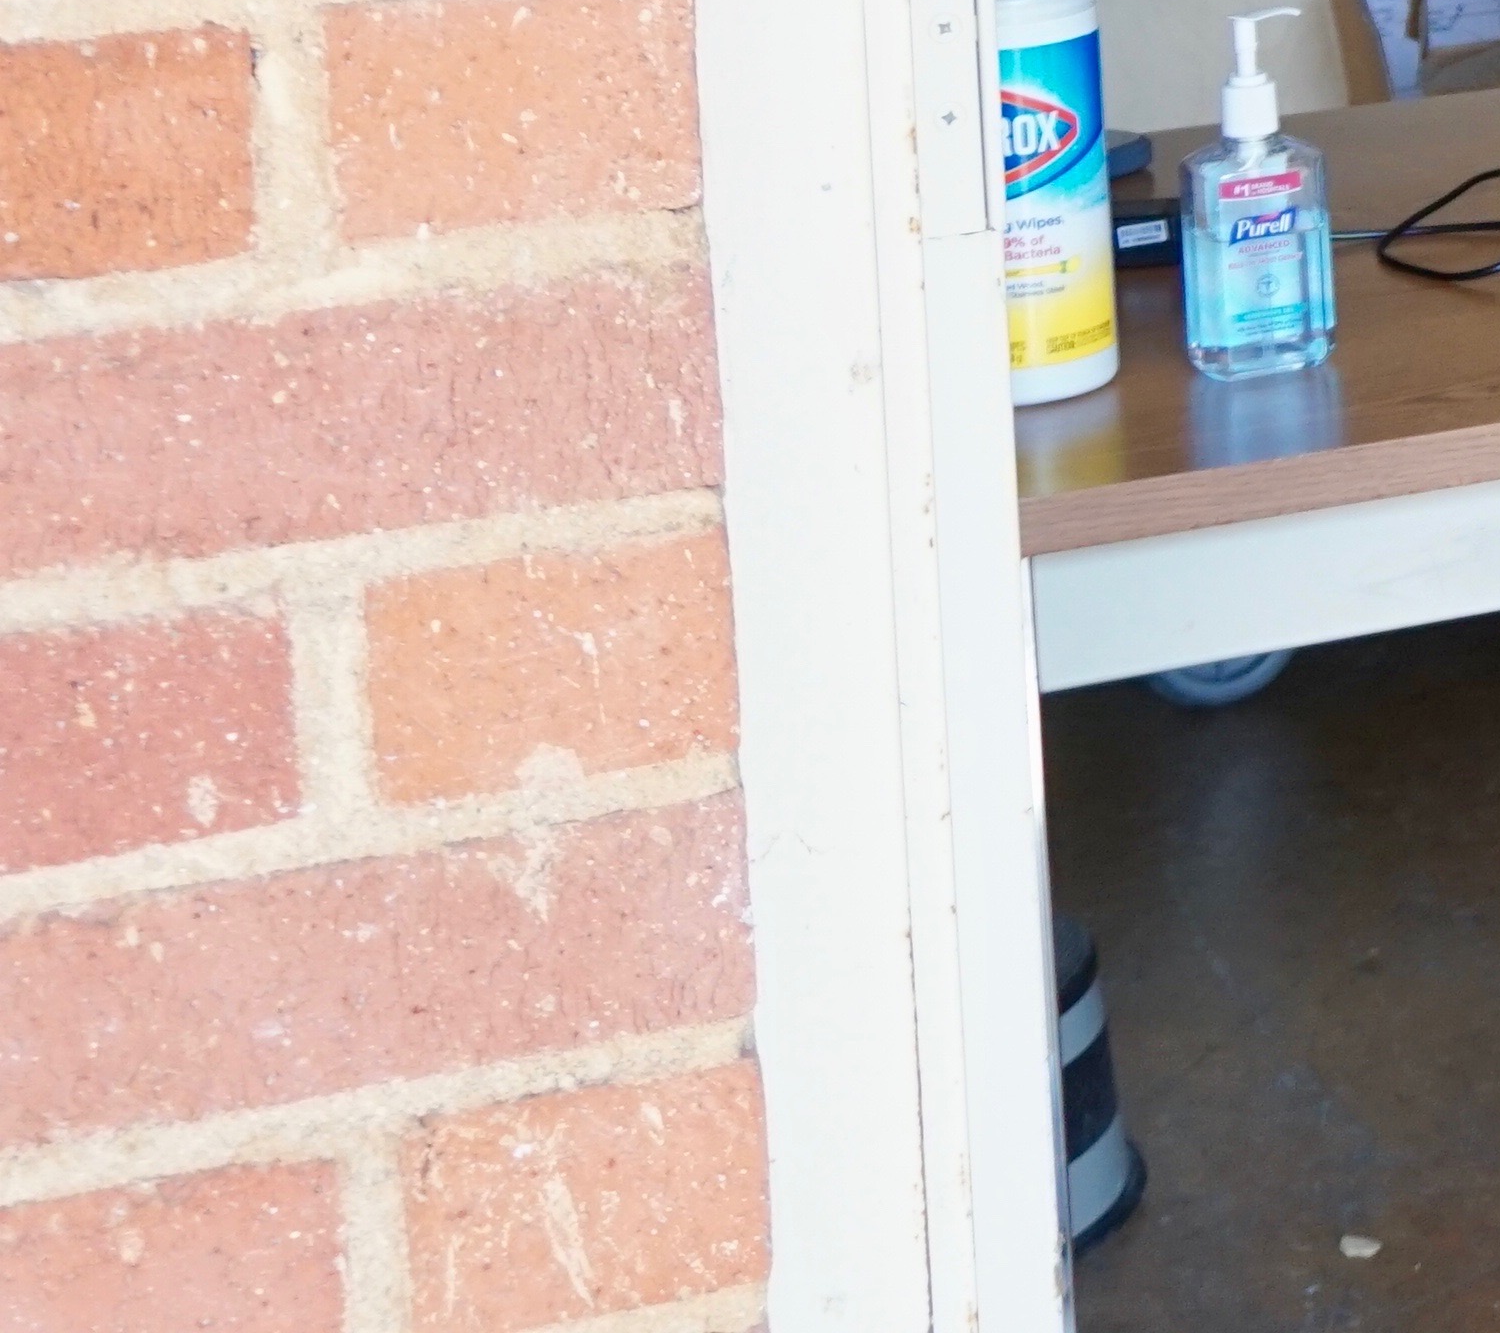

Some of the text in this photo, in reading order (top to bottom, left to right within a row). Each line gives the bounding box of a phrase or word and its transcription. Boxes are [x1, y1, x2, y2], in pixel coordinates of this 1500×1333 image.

[1233, 183, 1250, 197] #1
[1236, 212, 1293, 240] Purell
[1238, 239, 1290, 254] ADVANCED
